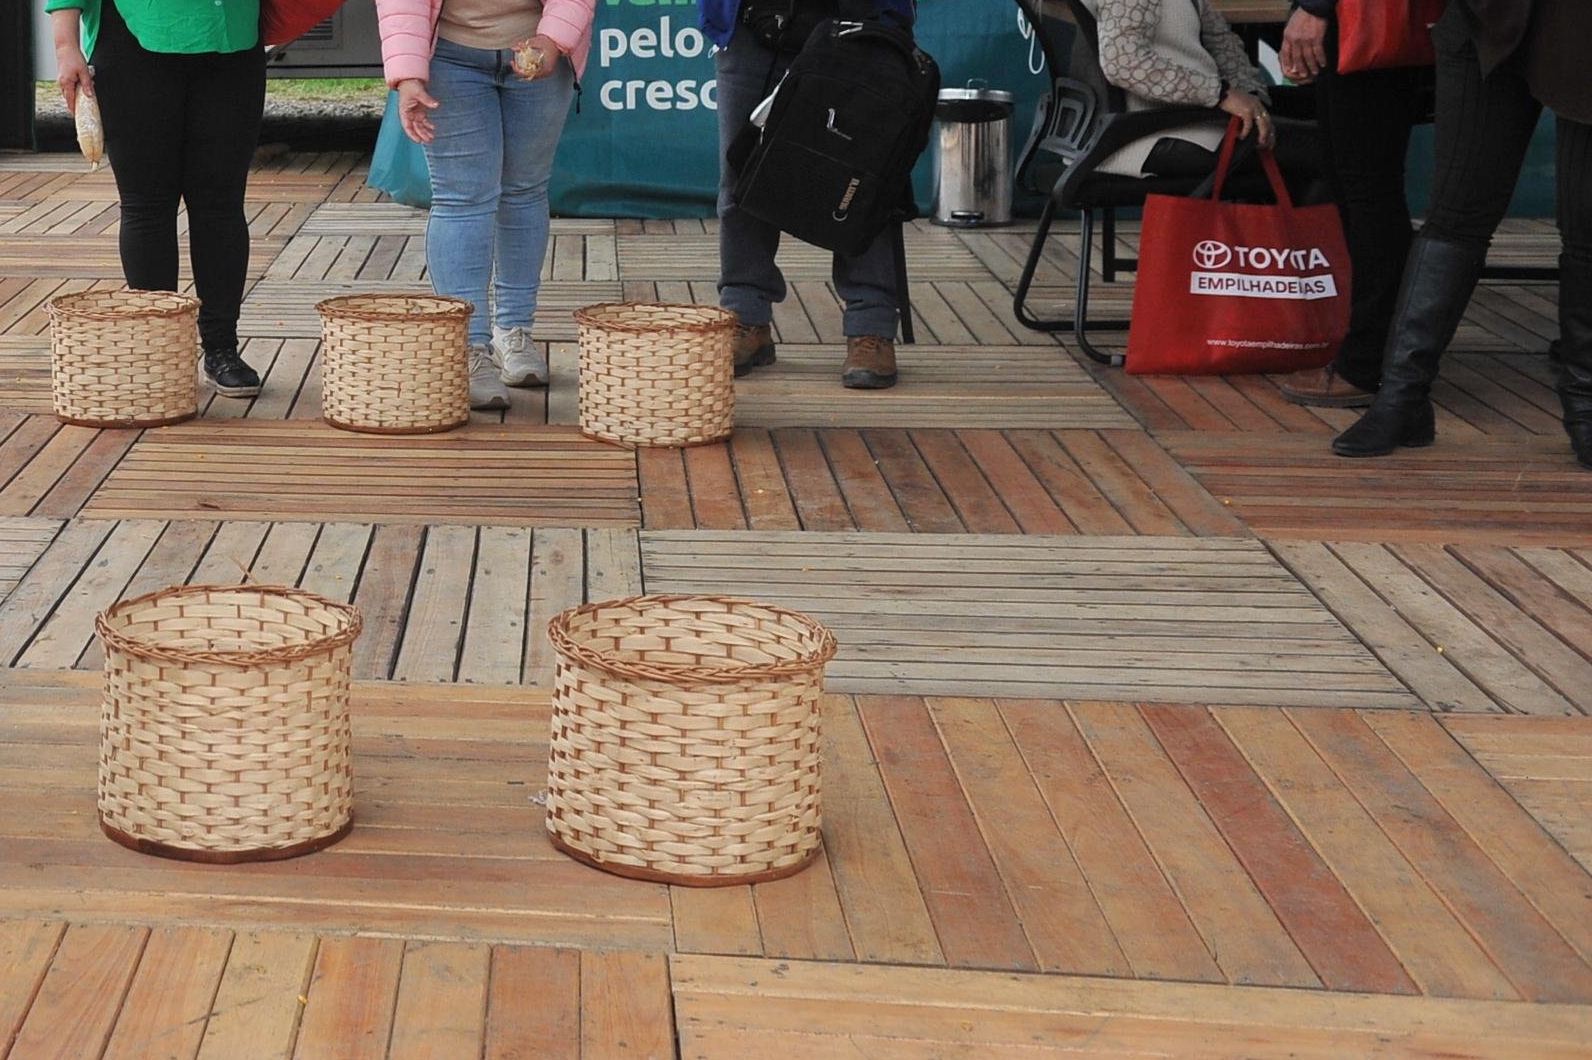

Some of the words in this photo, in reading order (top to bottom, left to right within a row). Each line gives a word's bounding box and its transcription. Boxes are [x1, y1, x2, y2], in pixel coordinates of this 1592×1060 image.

[600, 15, 705, 68] pelo
[600, 78, 718, 110] cresc
[1197, 276, 1327, 294] EMPILHADEIAS
